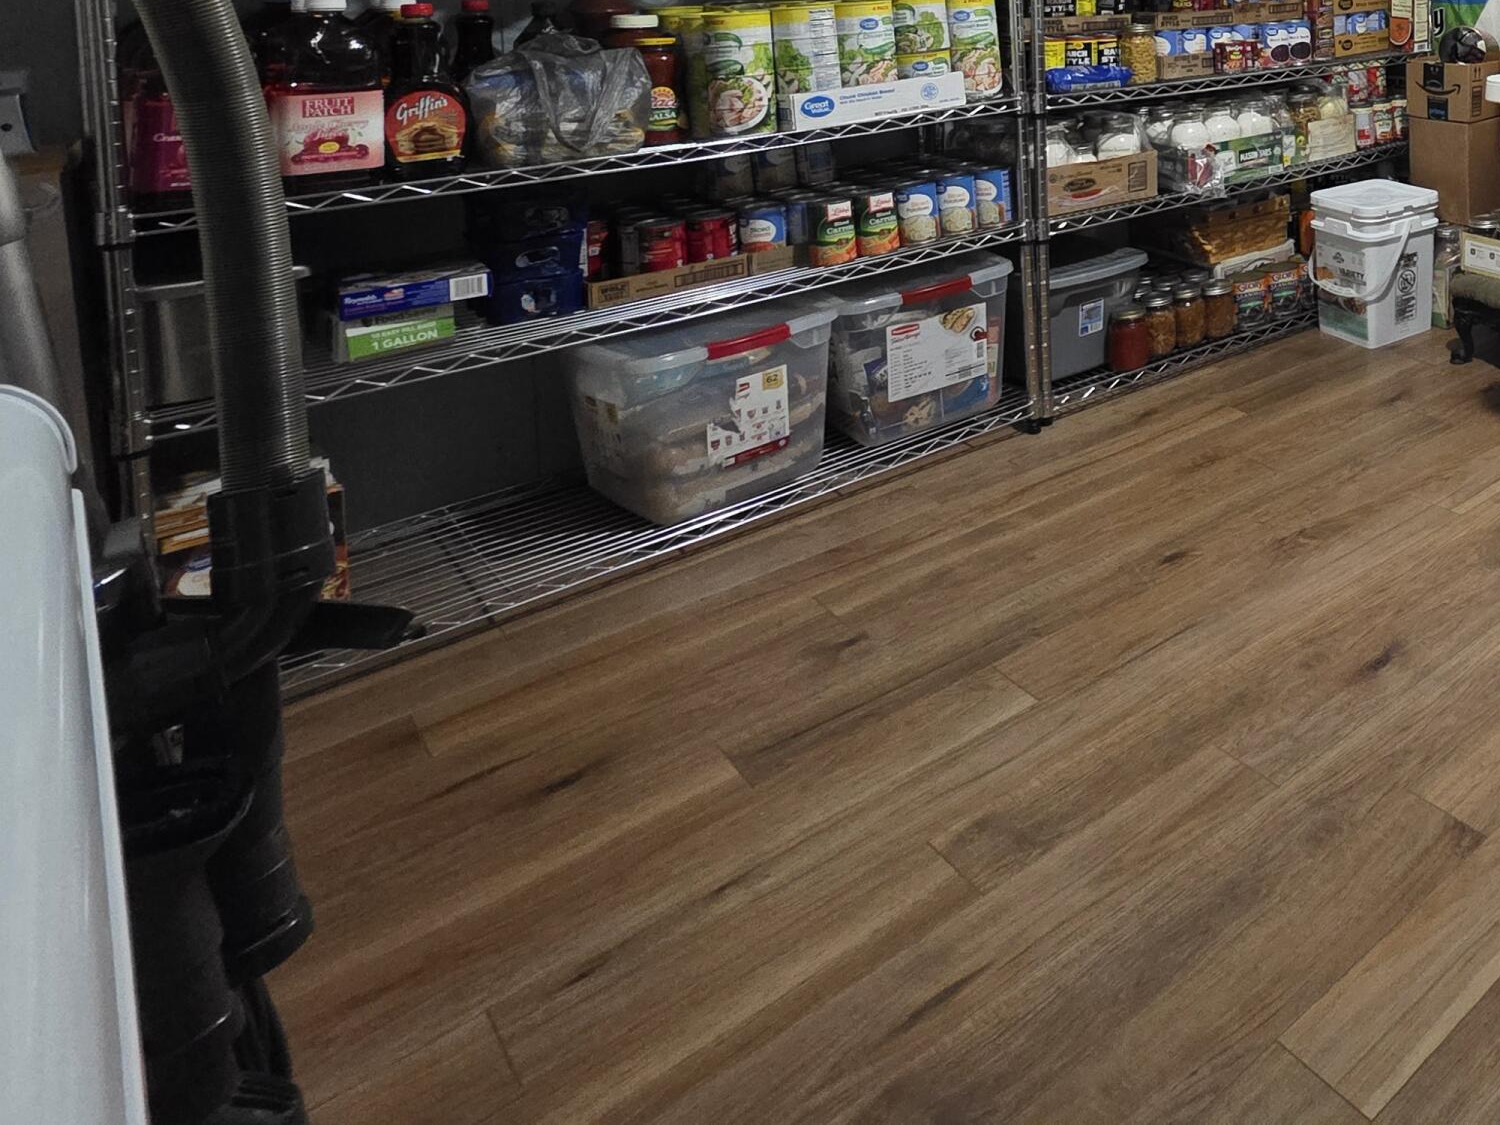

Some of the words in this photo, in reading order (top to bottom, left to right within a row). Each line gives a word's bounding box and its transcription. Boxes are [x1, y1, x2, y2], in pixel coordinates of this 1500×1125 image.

[1044, 4, 1074, 14] STYLE
[305, 97, 352, 108] FRUIT
[803, 101, 829, 113] Great
[305, 106, 353, 118] PATCH
[396, 95, 448, 124] Griffin's
[372, 341, 380, 351] 1
[382, 328, 439, 349] GALLON
